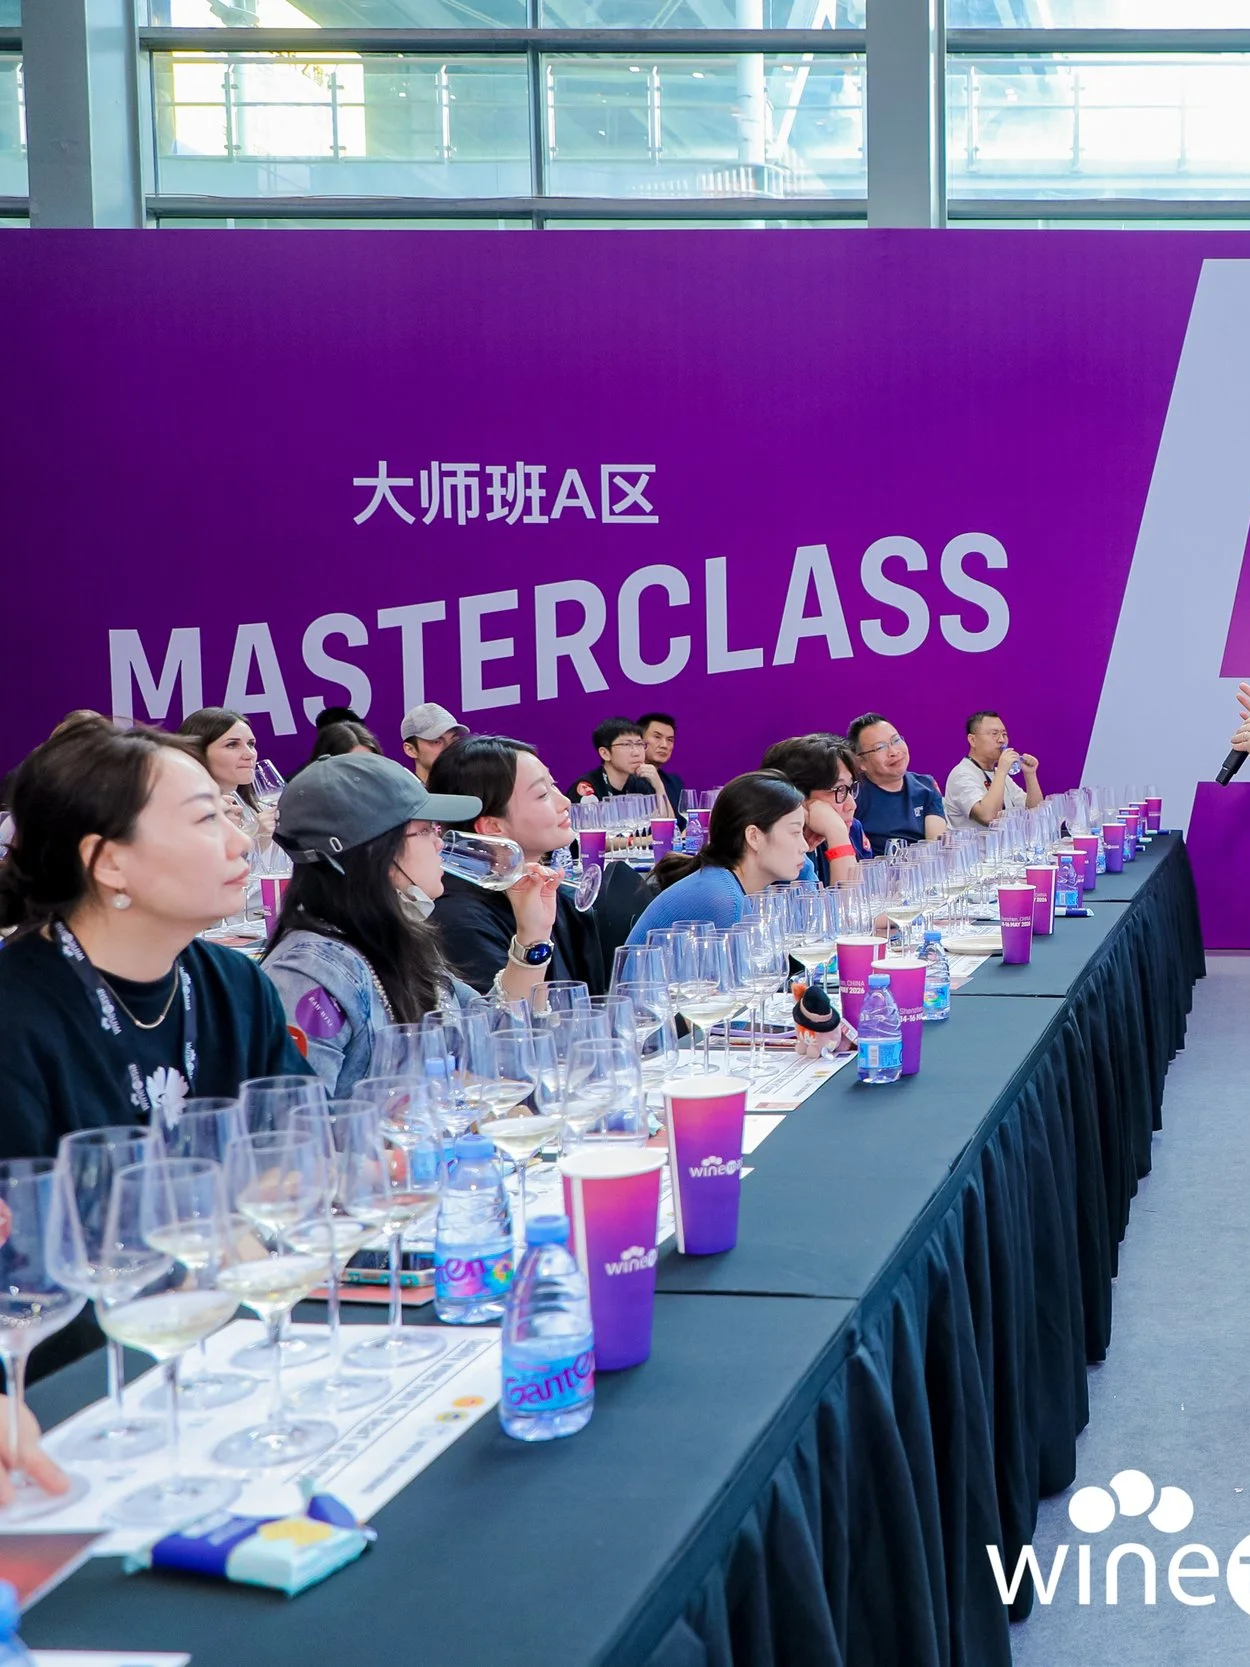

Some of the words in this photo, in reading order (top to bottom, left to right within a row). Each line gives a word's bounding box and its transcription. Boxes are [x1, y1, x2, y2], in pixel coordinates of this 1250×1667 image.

[352, 461, 660, 526] 大师班A区
[109, 532, 1011, 736] MASTERCLASS
